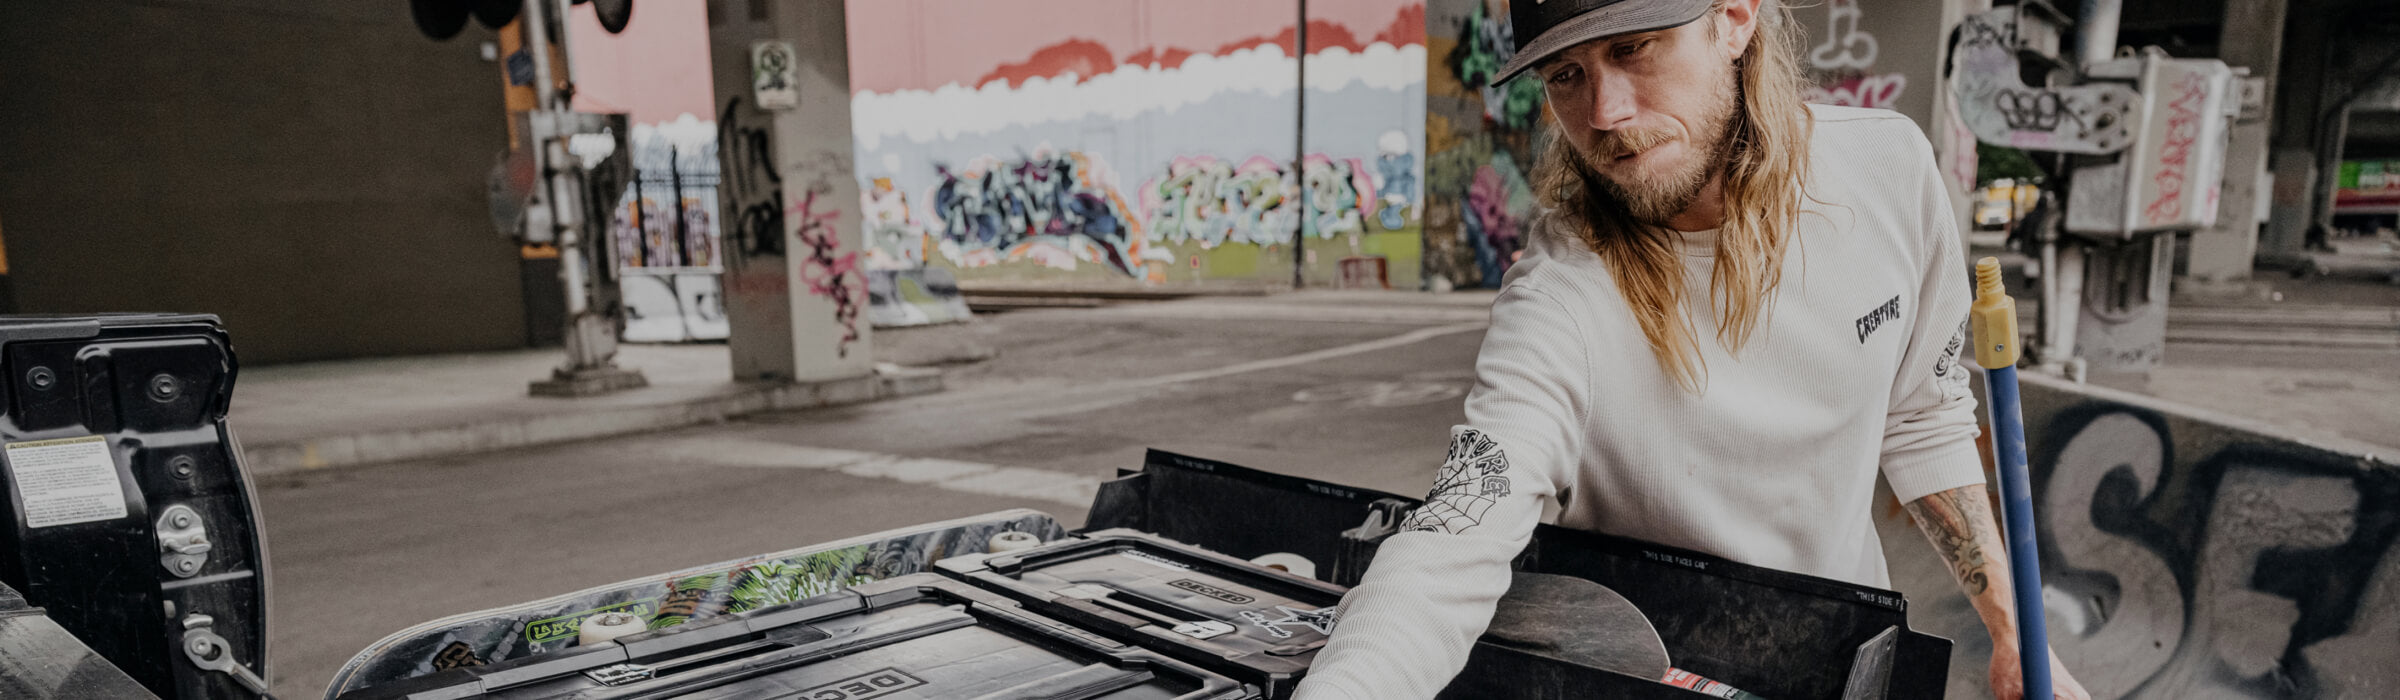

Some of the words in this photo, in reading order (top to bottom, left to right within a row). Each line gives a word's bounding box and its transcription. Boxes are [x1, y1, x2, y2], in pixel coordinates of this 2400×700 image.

[1178, 580, 1246, 604] DECKED
[1878, 595, 1893, 606] SIDE
[798, 674, 905, 700] DEC
